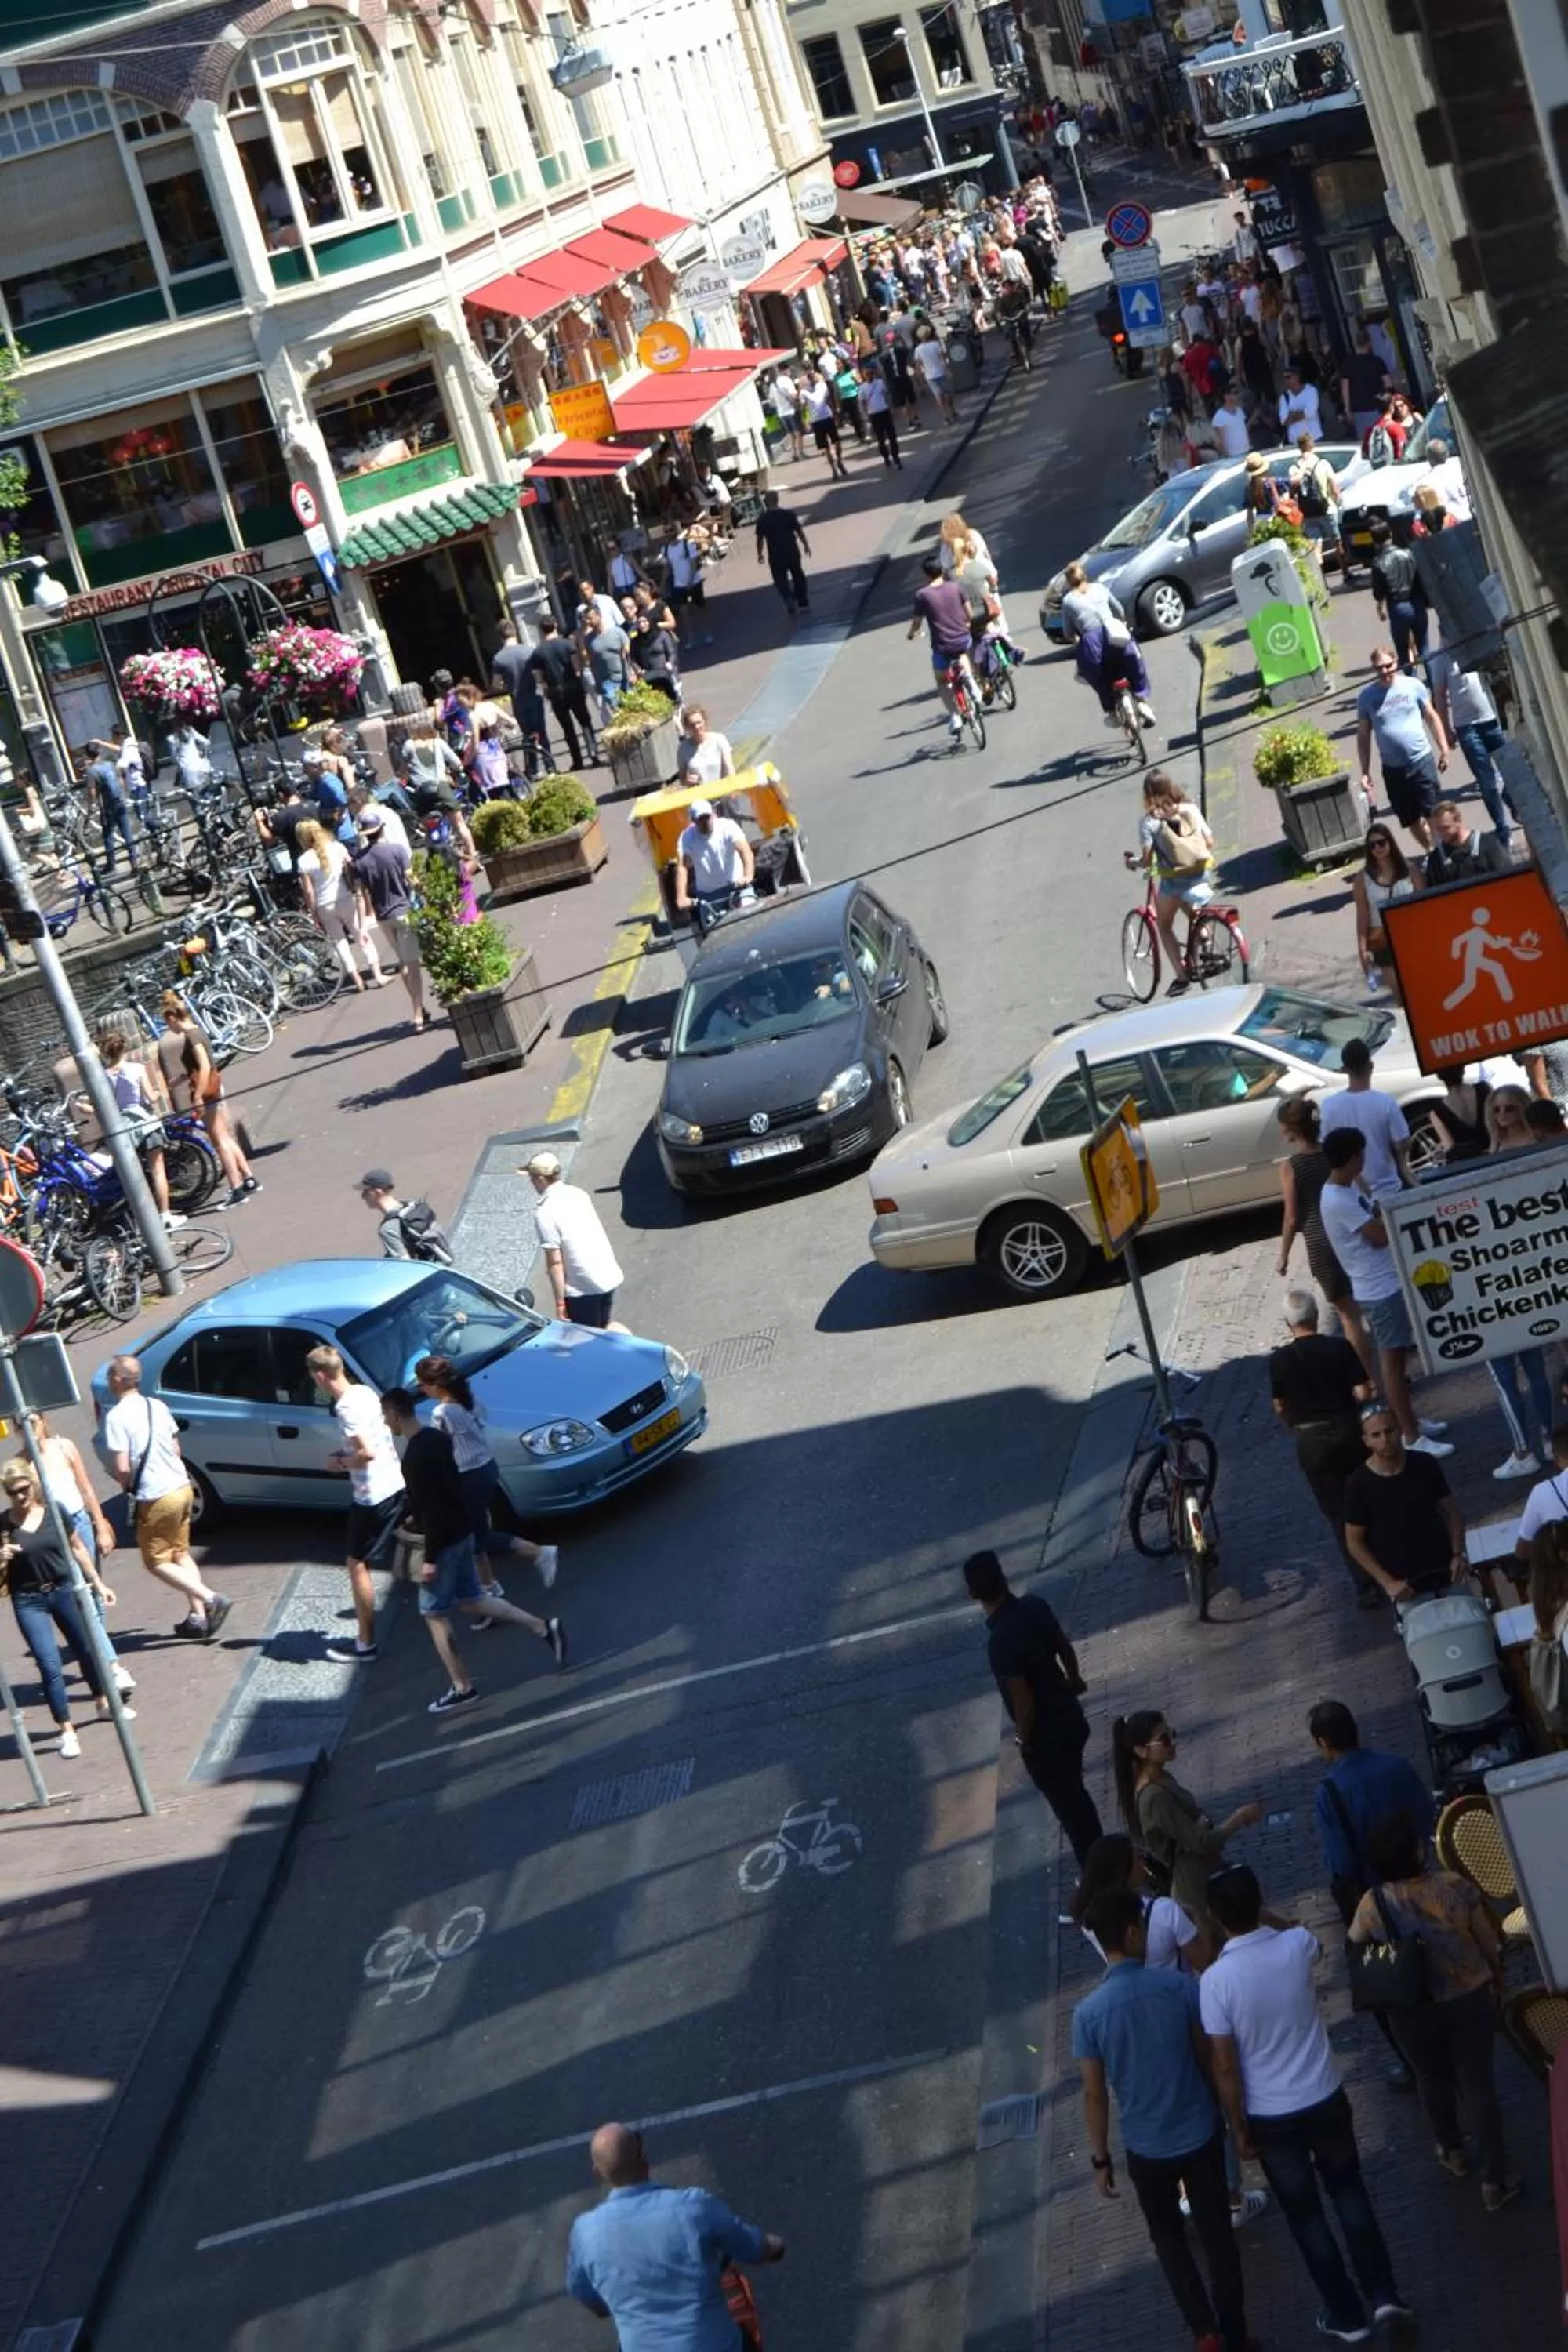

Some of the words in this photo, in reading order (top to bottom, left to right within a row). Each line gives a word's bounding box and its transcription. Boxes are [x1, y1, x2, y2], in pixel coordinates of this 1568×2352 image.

[684, 278, 728, 299] BAKERY
[232, 551, 265, 575] CITY
[1430, 1028, 1481, 1058] WOK
[1483, 1020, 1511, 1044] TO
[1436, 1196, 1481, 1218] test
[1400, 1214, 1481, 1254] The
[1475, 1256, 1568, 1298] Falafe
